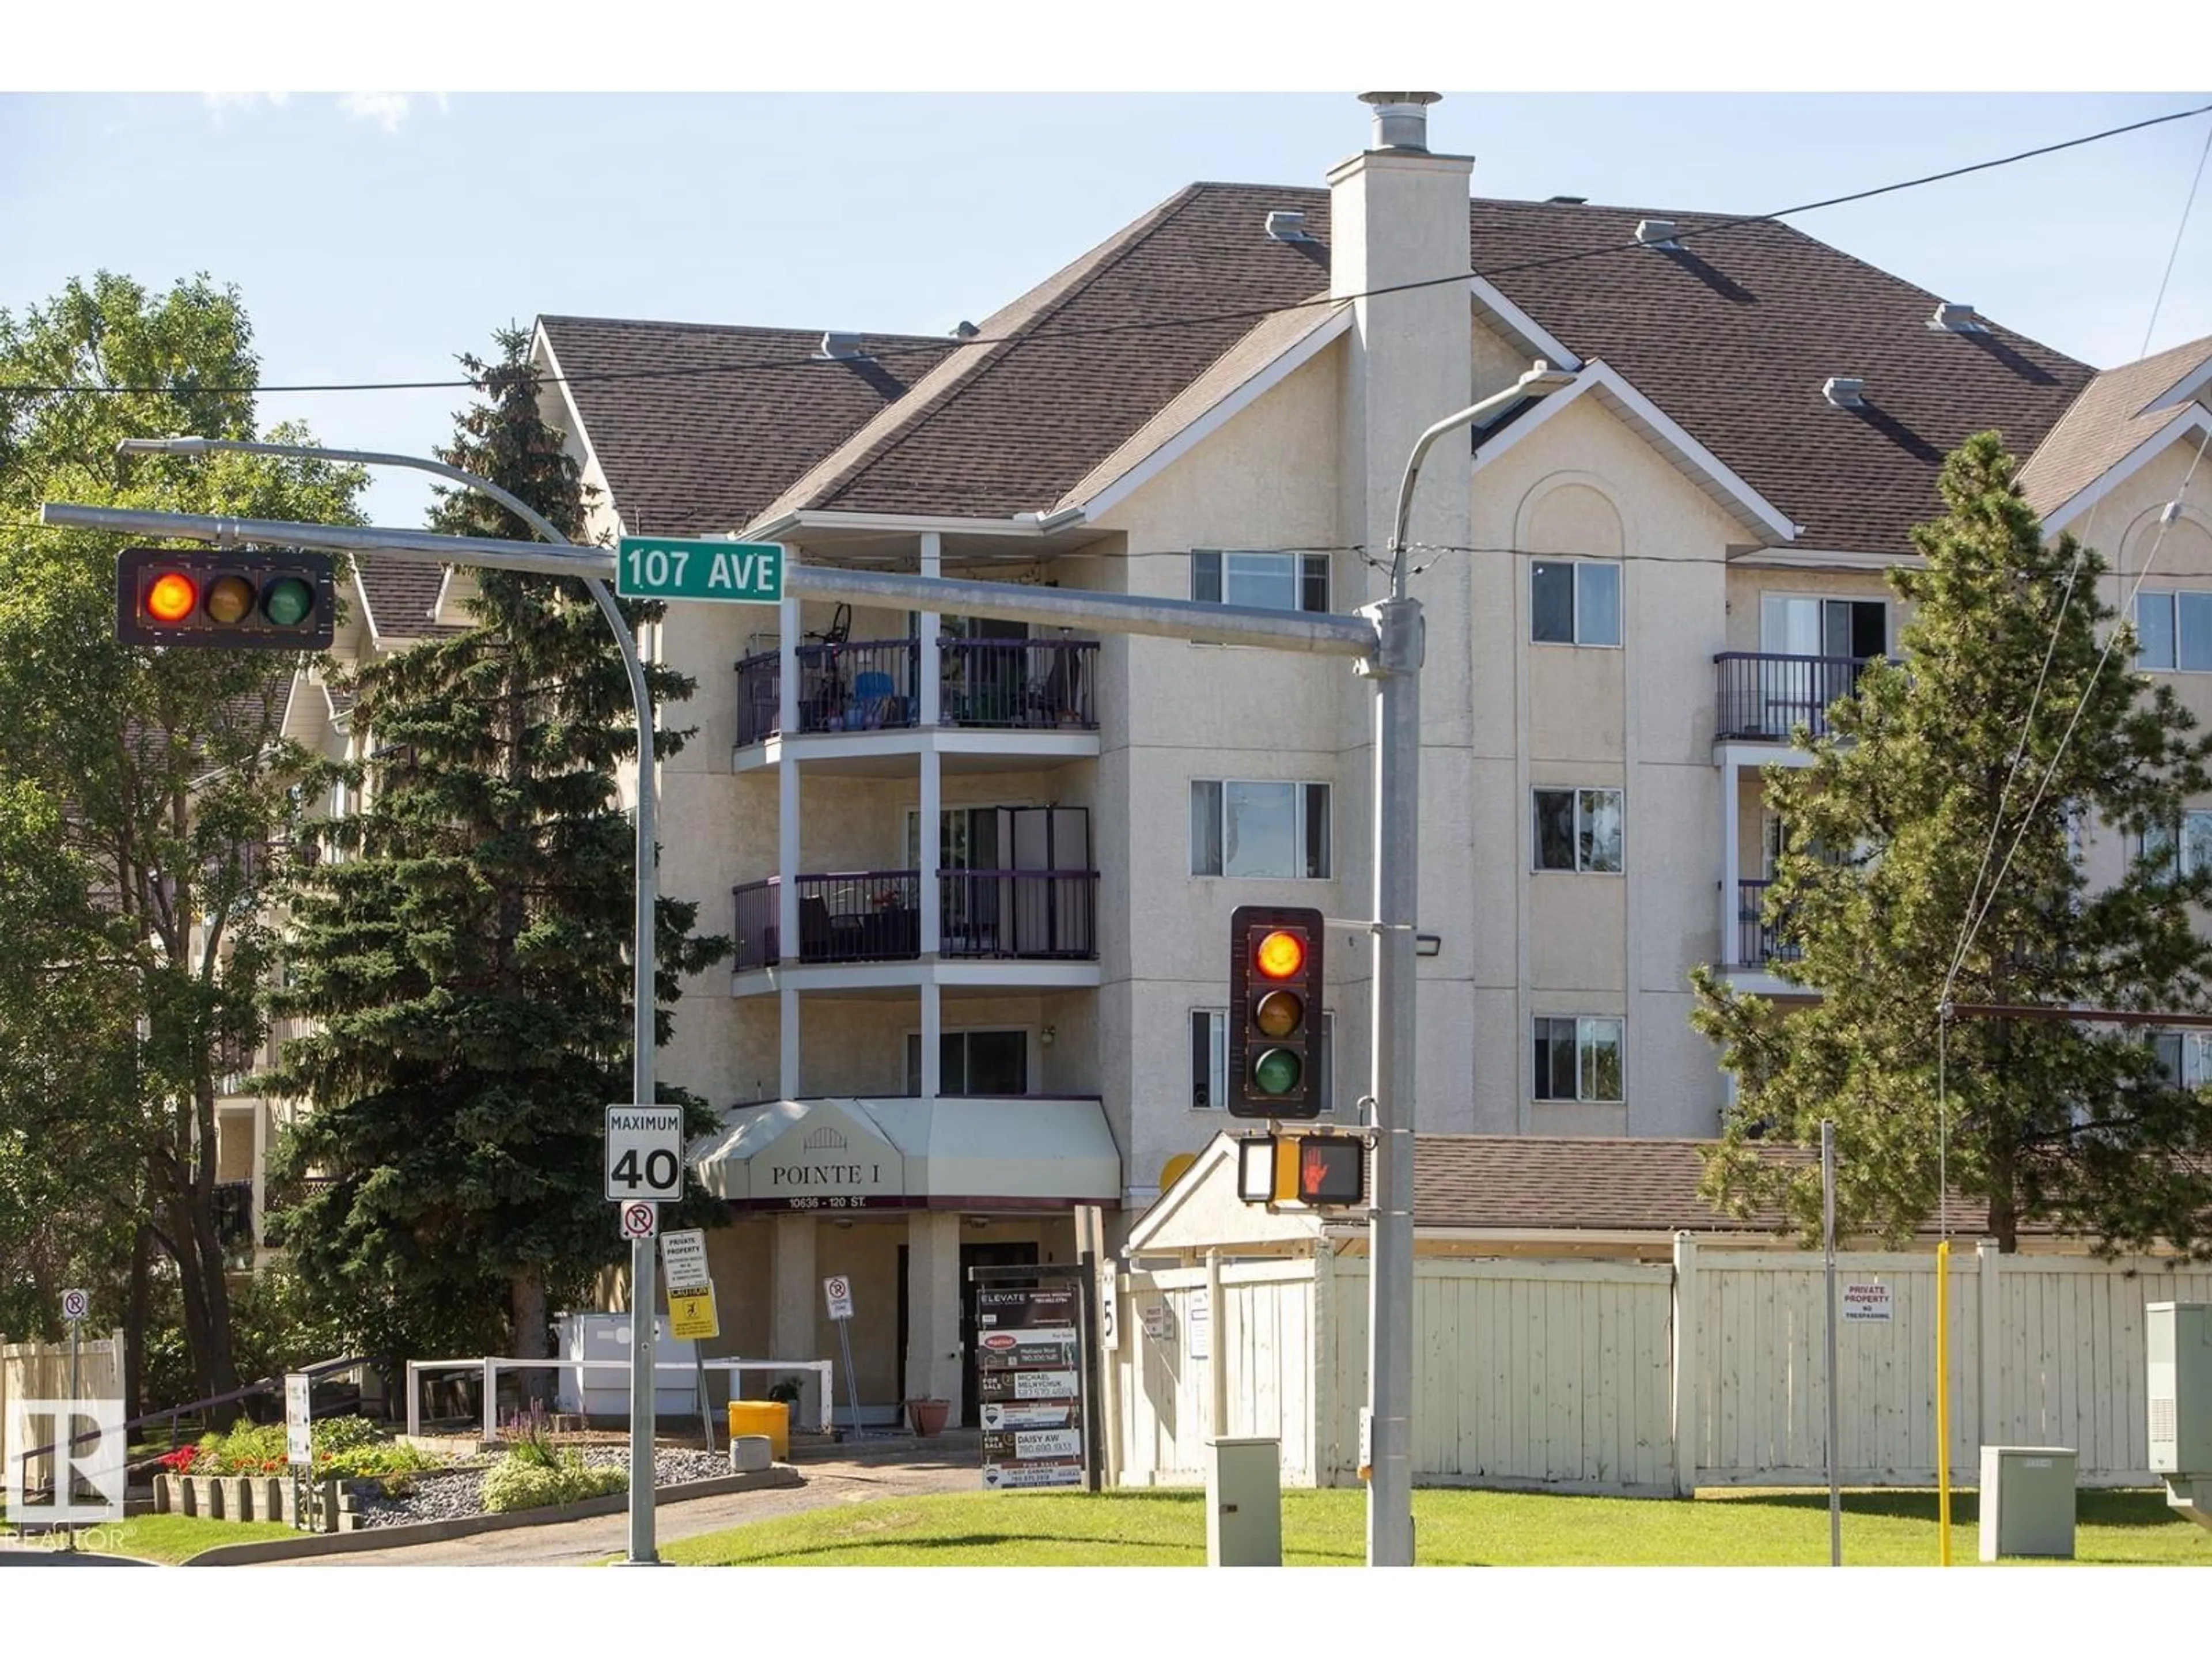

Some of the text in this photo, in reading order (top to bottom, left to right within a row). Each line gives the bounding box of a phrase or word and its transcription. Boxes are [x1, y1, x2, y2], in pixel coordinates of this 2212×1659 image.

[628, 549, 774, 590] 107 AVE
[611, 1116, 678, 1130] MAXIMUM
[611, 1149, 678, 1190] 40
[772, 1164, 862, 1185] POINTE
[789, 1198, 819, 1209] 10636
[830, 1197, 846, 1207] 120
[669, 1237, 696, 1246] PRIVATE
[666, 1247, 700, 1255] PROPERTY
[672, 1287, 708, 1297] CAUTION
[1849, 1286, 1885, 1294] PRIVATE
[982, 1294, 1025, 1302] ELEVATE
[1844, 1295, 1889, 1303] PROPERTY
[1018, 1434, 1059, 1444] DAISY AW
